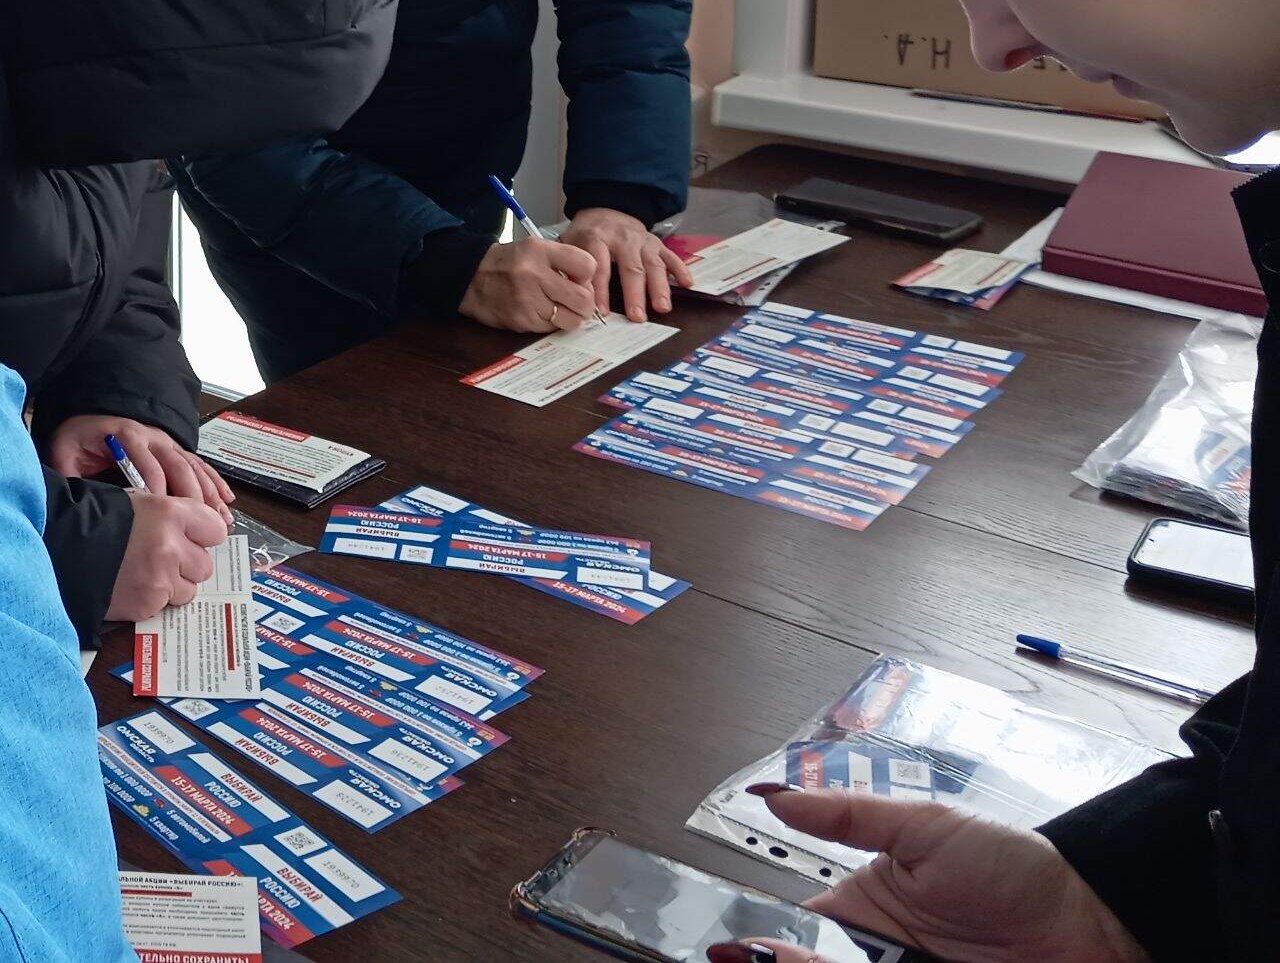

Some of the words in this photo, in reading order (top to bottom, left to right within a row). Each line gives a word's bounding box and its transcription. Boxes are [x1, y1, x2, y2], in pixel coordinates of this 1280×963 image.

[360, 520, 399, 529] РОССИЮ
[483, 554, 524, 566] РОССИЮ
[264, 578, 301, 597] РОССИЮ
[331, 646, 375, 667] ВЫБИРАЙ
[344, 640, 385, 659] РОССИЮ
[285, 702, 331, 727] ВЫБИРАЙ
[301, 695, 343, 718] РОССИЮ
[116, 725, 156, 755] ОМСКАЯ
[234, 737, 279, 766] ВЫБИРАЙ
[253, 731, 293, 756] РОССИЮ
[401, 735, 455, 764] ОМСКАЯ
[169, 775, 196, 794] 15-17
[188, 789, 218, 811] МАРТА
[211, 807, 234, 824] 2024
[204, 781, 241, 808] РОССИЮ
[220, 773, 261, 803] ВЫБИРАЙ
[350, 777, 402, 808] ОМСКАЯ
[119, 876, 143, 884] ЛЬНОЙ
[260, 877, 300, 908] РОССИЮ
[276, 867, 323, 902] ВЫБИРАЙ
[268, 909, 294, 931] 2024
[140, 953, 181, 963] ТЕЛЬНО
